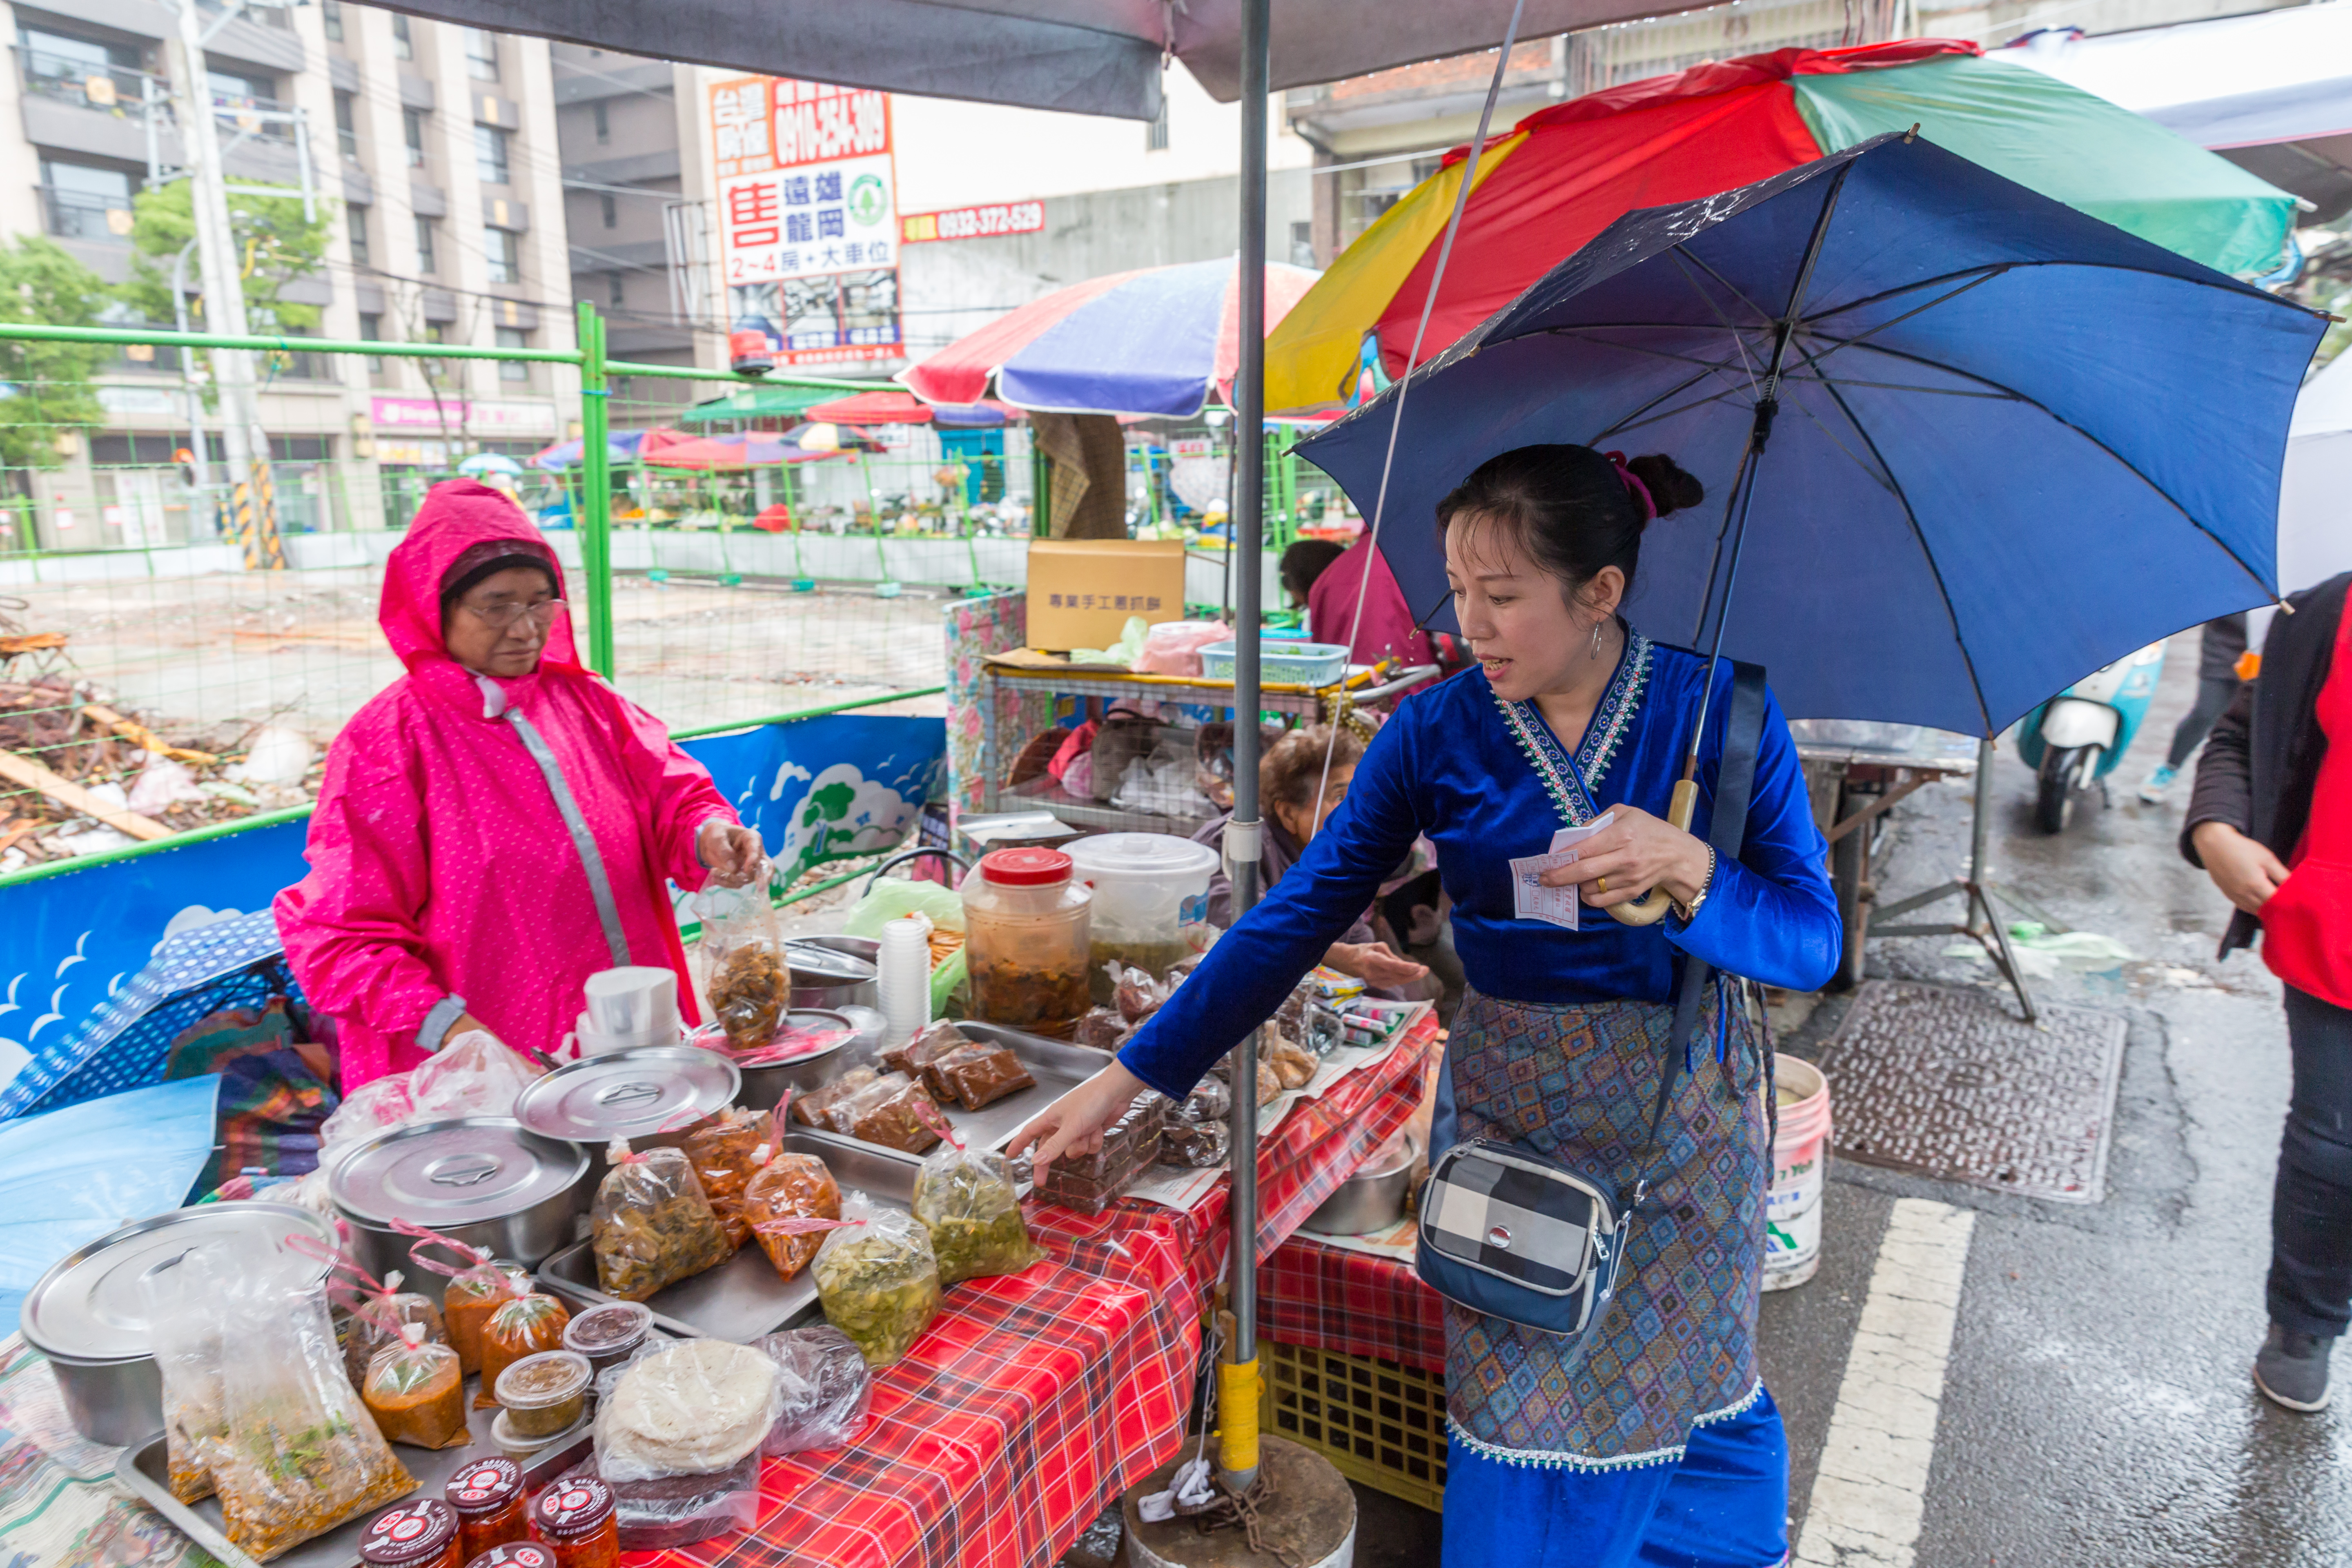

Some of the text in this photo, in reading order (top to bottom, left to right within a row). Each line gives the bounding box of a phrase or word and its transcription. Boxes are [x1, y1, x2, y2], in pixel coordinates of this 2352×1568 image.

[784, 171, 842, 205] 遠雄
[728, 183, 779, 248] 售
[938, 202, 1042, 238] 0932-372-529
